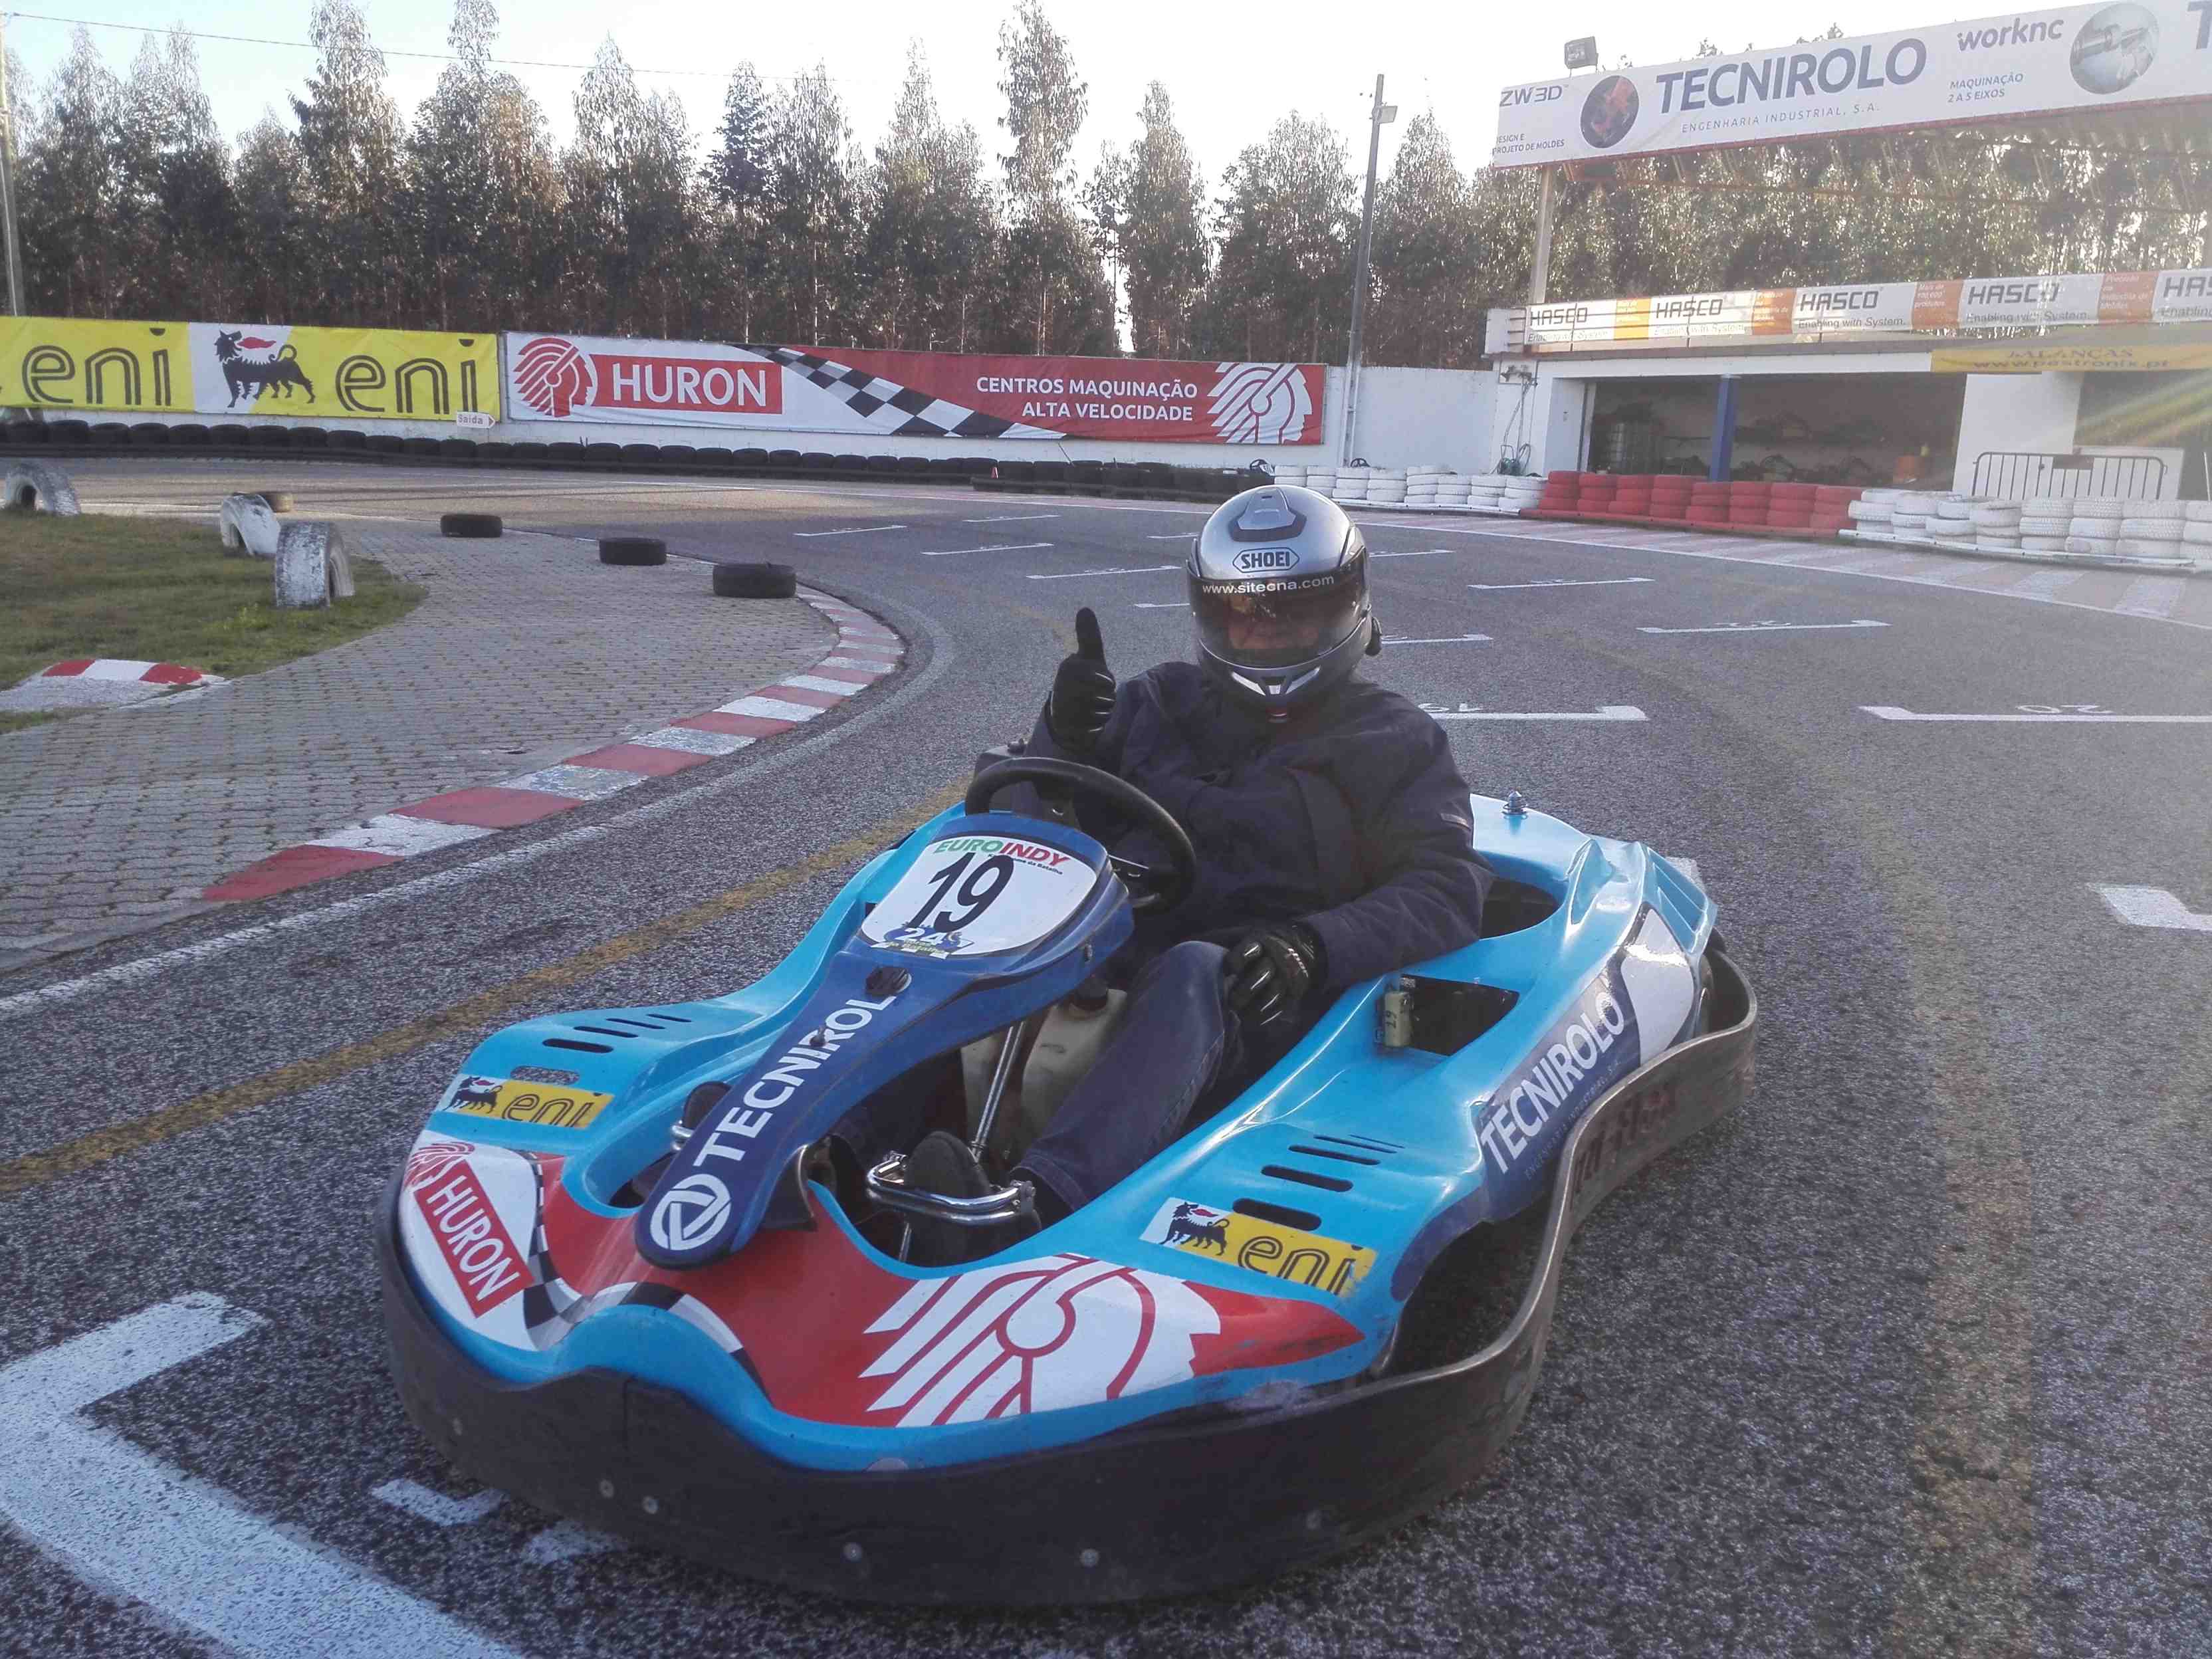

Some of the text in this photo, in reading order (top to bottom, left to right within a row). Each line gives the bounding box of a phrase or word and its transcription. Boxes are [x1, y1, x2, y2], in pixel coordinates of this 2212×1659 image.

[1655, 38, 1927, 114] TECNIROLO
[1950, 72, 2023, 89] MAQUINAÇÃO
[1974, 89, 2005, 100] EIXOS
[1682, 116, 1759, 133] ENGENHARIA
[1536, 139, 1565, 149] MOLDES
[1656, 299, 1723, 318] HASCO
[1800, 291, 1879, 311] HASCO
[1530, 307, 1588, 326] HASCO
[1842, 318, 1862, 327] with
[22, 328, 172, 406] eni
[335, 339, 478, 415] eni
[613, 363, 767, 407] HURON
[976, 376, 1198, 401] CENTROS MAQUINAÇÃO
[1022, 401, 1193, 422] ALTA VELOCIDADE
[1241, 551, 1291, 569] SHOEI
[934, 839, 1071, 867] EUROINDY
[905, 851, 1014, 932] 19
[894, 927, 947, 945] 24
[693, 973, 912, 1167] TECNIROL
[1480, 992, 1624, 1174] TECNIROLO
[501, 1091, 602, 1128] eni
[426, 1174, 520, 1301] HURON
[1238, 1235, 1363, 1295] eni
